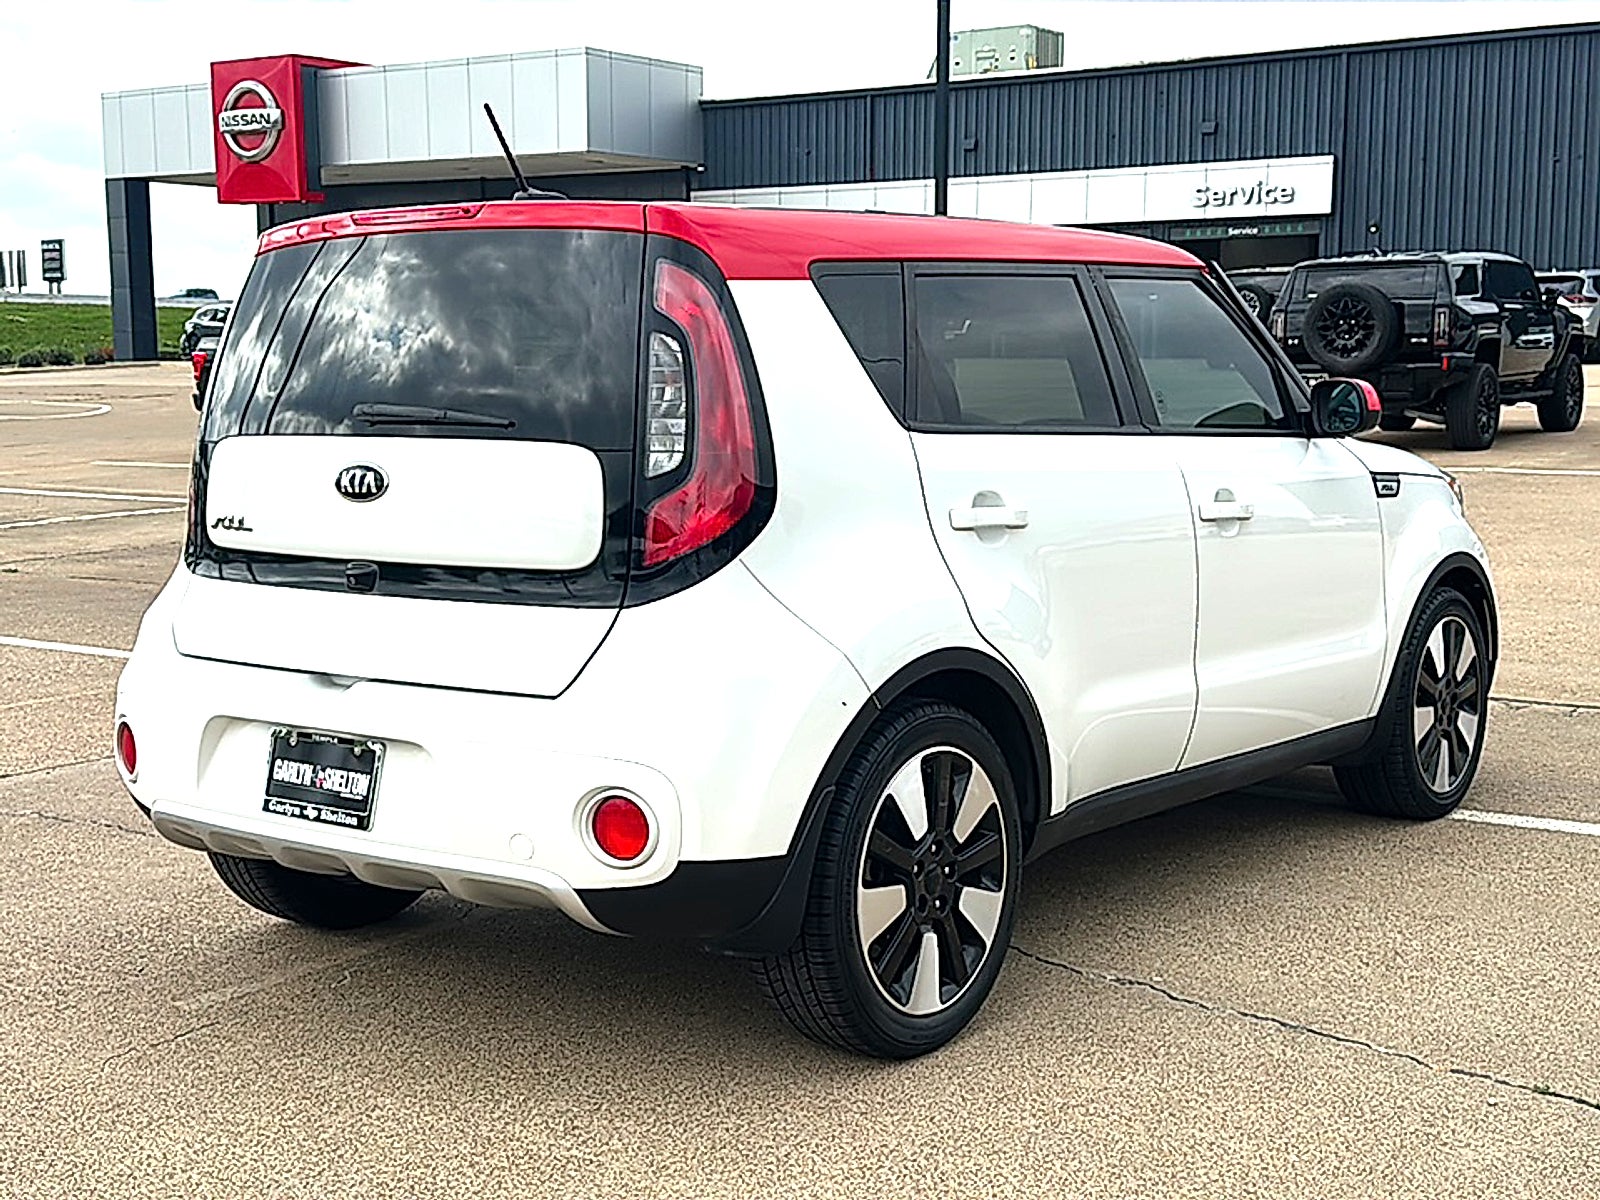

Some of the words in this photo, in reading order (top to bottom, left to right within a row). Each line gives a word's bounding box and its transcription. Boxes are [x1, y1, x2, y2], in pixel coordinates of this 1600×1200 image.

[220, 112, 272, 128] NISSAN
[1192, 180, 1295, 208] Service
[1227, 226, 1260, 236] Service
[340, 469, 378, 493] KIA
[323, 767, 371, 796] SHELTON
[320, 809, 358, 825] Shelton
